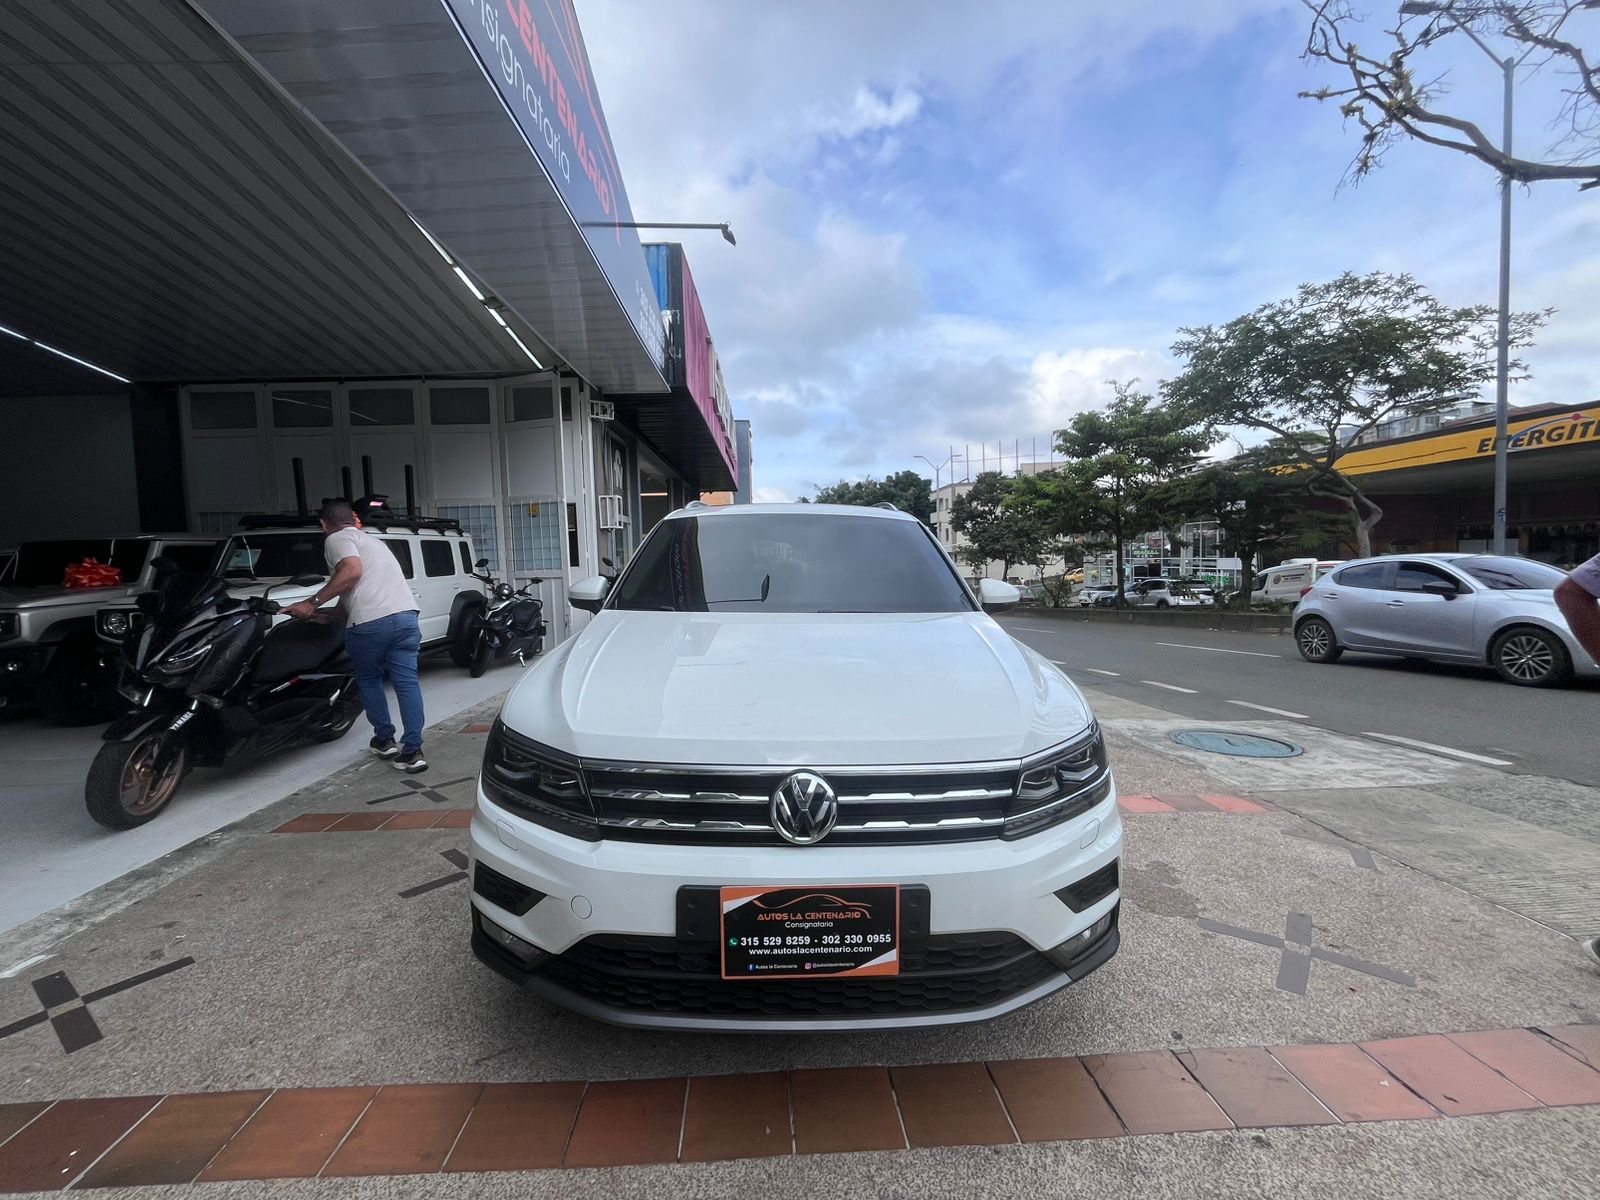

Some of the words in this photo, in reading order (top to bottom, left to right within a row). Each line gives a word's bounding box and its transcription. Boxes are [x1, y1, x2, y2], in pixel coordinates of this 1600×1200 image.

[168, 711, 194, 731] YAMAHA
[757, 912, 789, 921] AUTOS
[790, 912, 803, 920] LA
[805, 911, 861, 919] CENTENARIO
[785, 921, 834, 929] Consignataria
[740, 937, 759, 946] 315
[763, 936, 782, 945] 529
[785, 935, 811, 945] 8259
[822, 935, 840, 944] 302
[844, 934, 863, 944] 330
[867, 933, 892, 943] 0955
[748, 945, 873, 955] www.autoslacentenario.com
